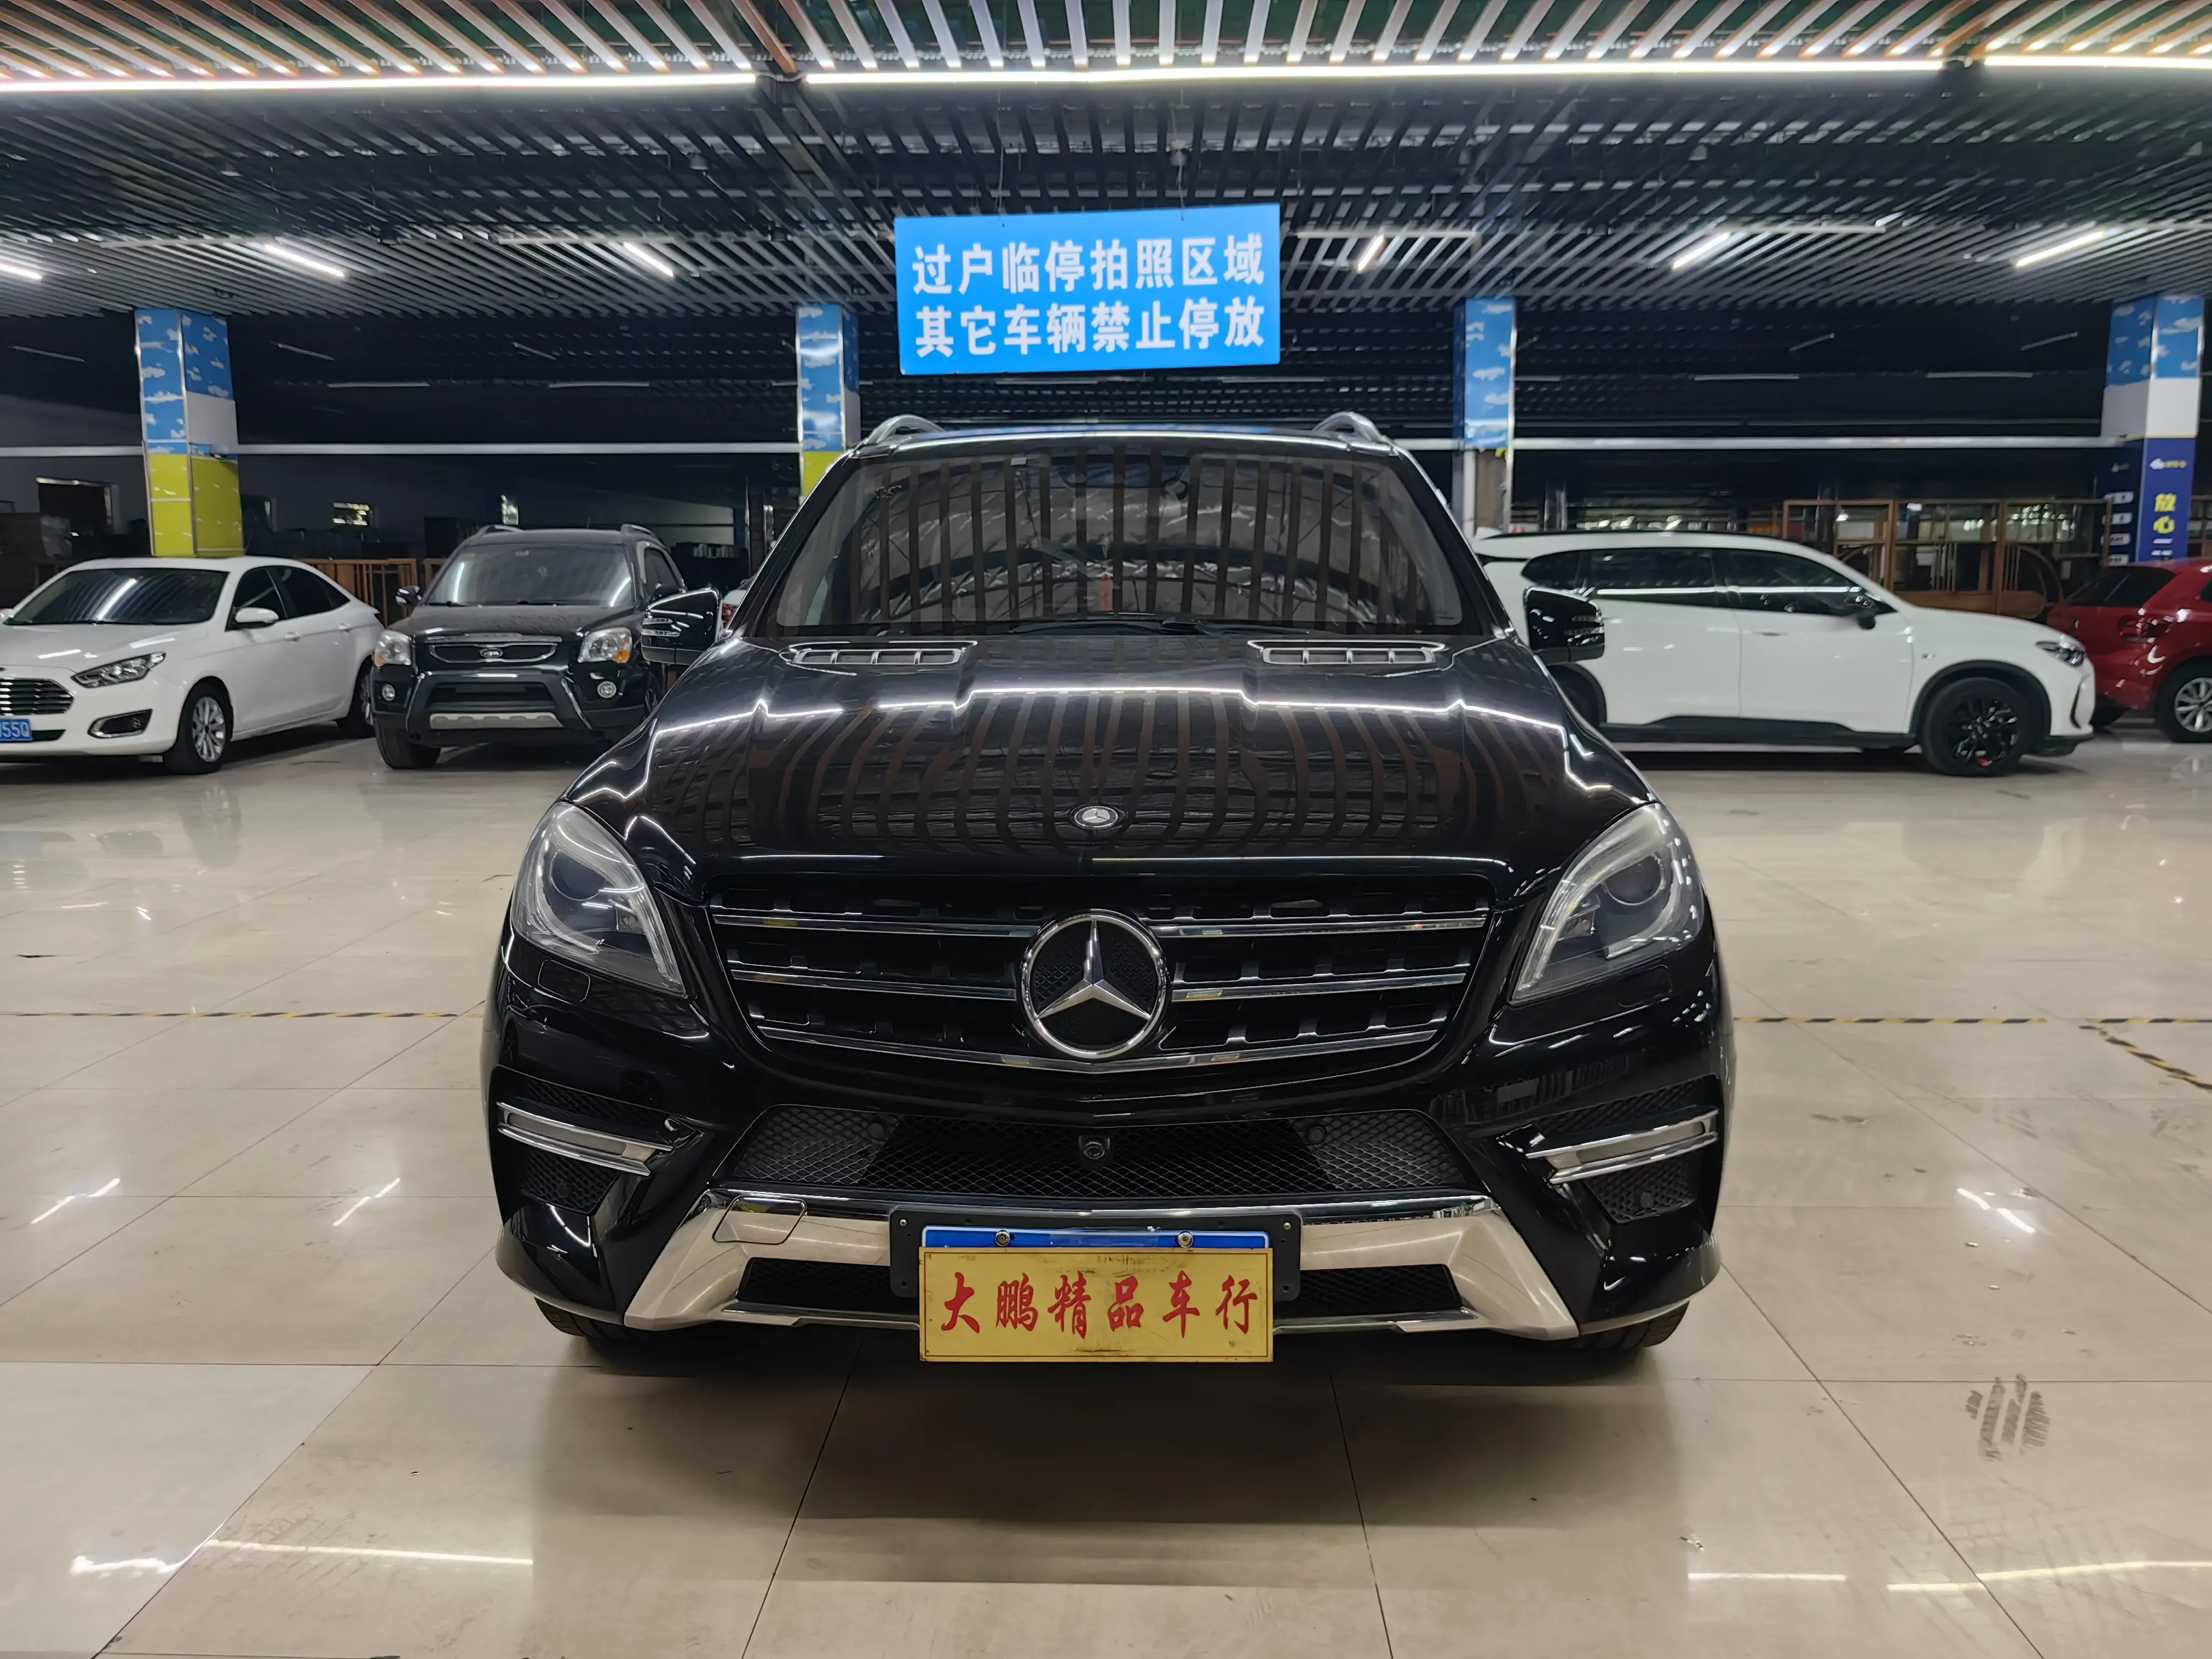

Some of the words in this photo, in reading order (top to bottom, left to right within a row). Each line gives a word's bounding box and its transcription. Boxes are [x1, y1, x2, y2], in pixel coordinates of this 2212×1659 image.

[912, 232, 1265, 295] 过户临停拍照区域
[915, 295, 1265, 358] 其它车辆禁止停放
[940, 1270, 1258, 1339] 大鹏精品车行
